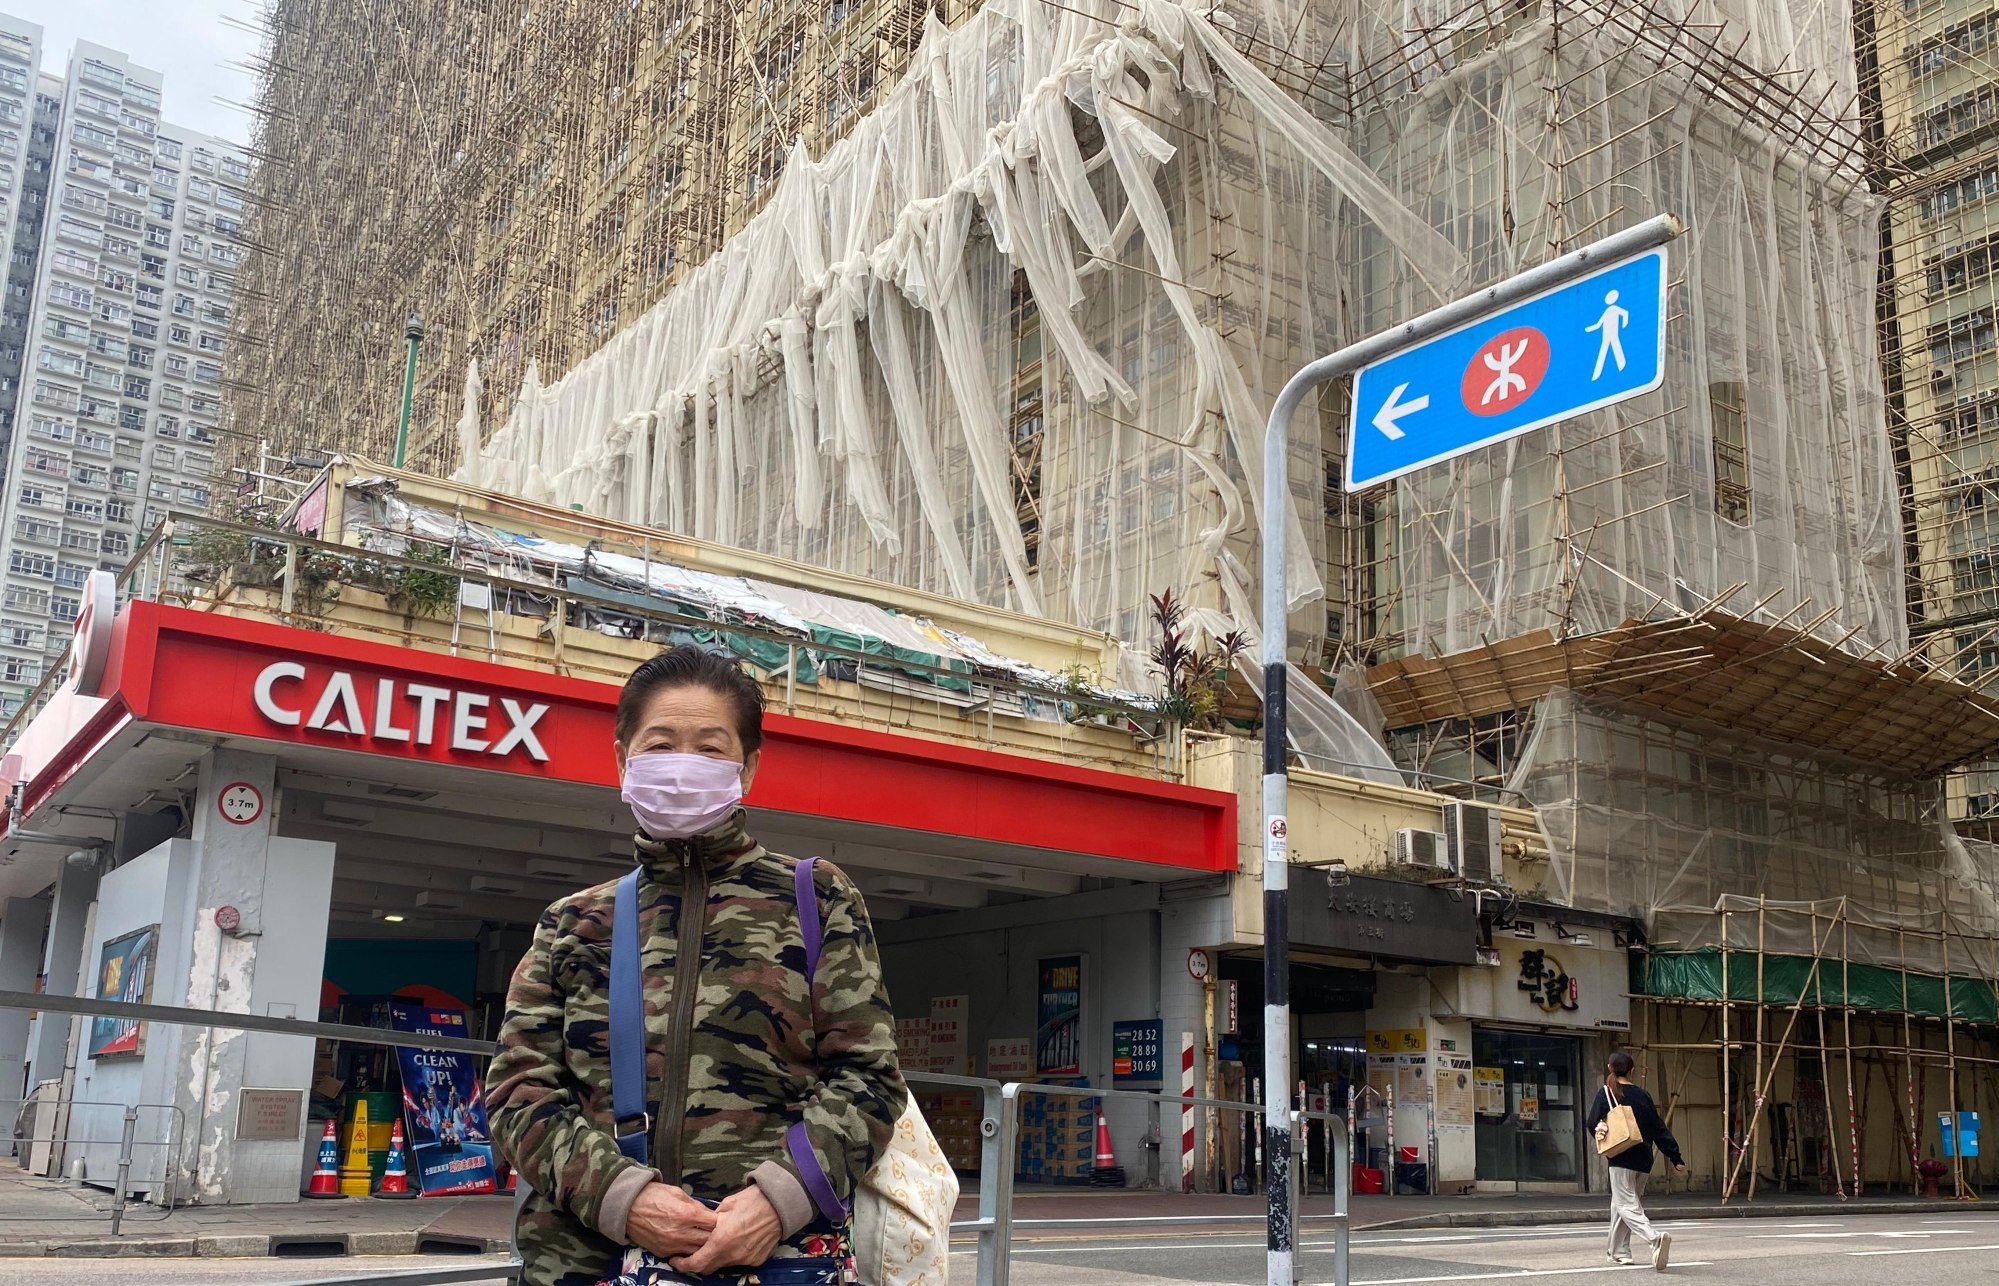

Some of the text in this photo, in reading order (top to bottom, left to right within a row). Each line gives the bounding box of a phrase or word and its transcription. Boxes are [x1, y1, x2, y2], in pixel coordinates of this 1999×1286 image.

[254, 661, 550, 763] CALTEX
[228, 798, 254, 810] 3.7m
[1053, 966, 1079, 990] DRIVE
[1132, 1029, 1157, 1041] 28.52
[1132, 1045, 1157, 1057] 28.89
[413, 1054, 458, 1068] CLEAN
[1132, 1060, 1157, 1072] 30.69
[426, 1070, 453, 1086] UP!
